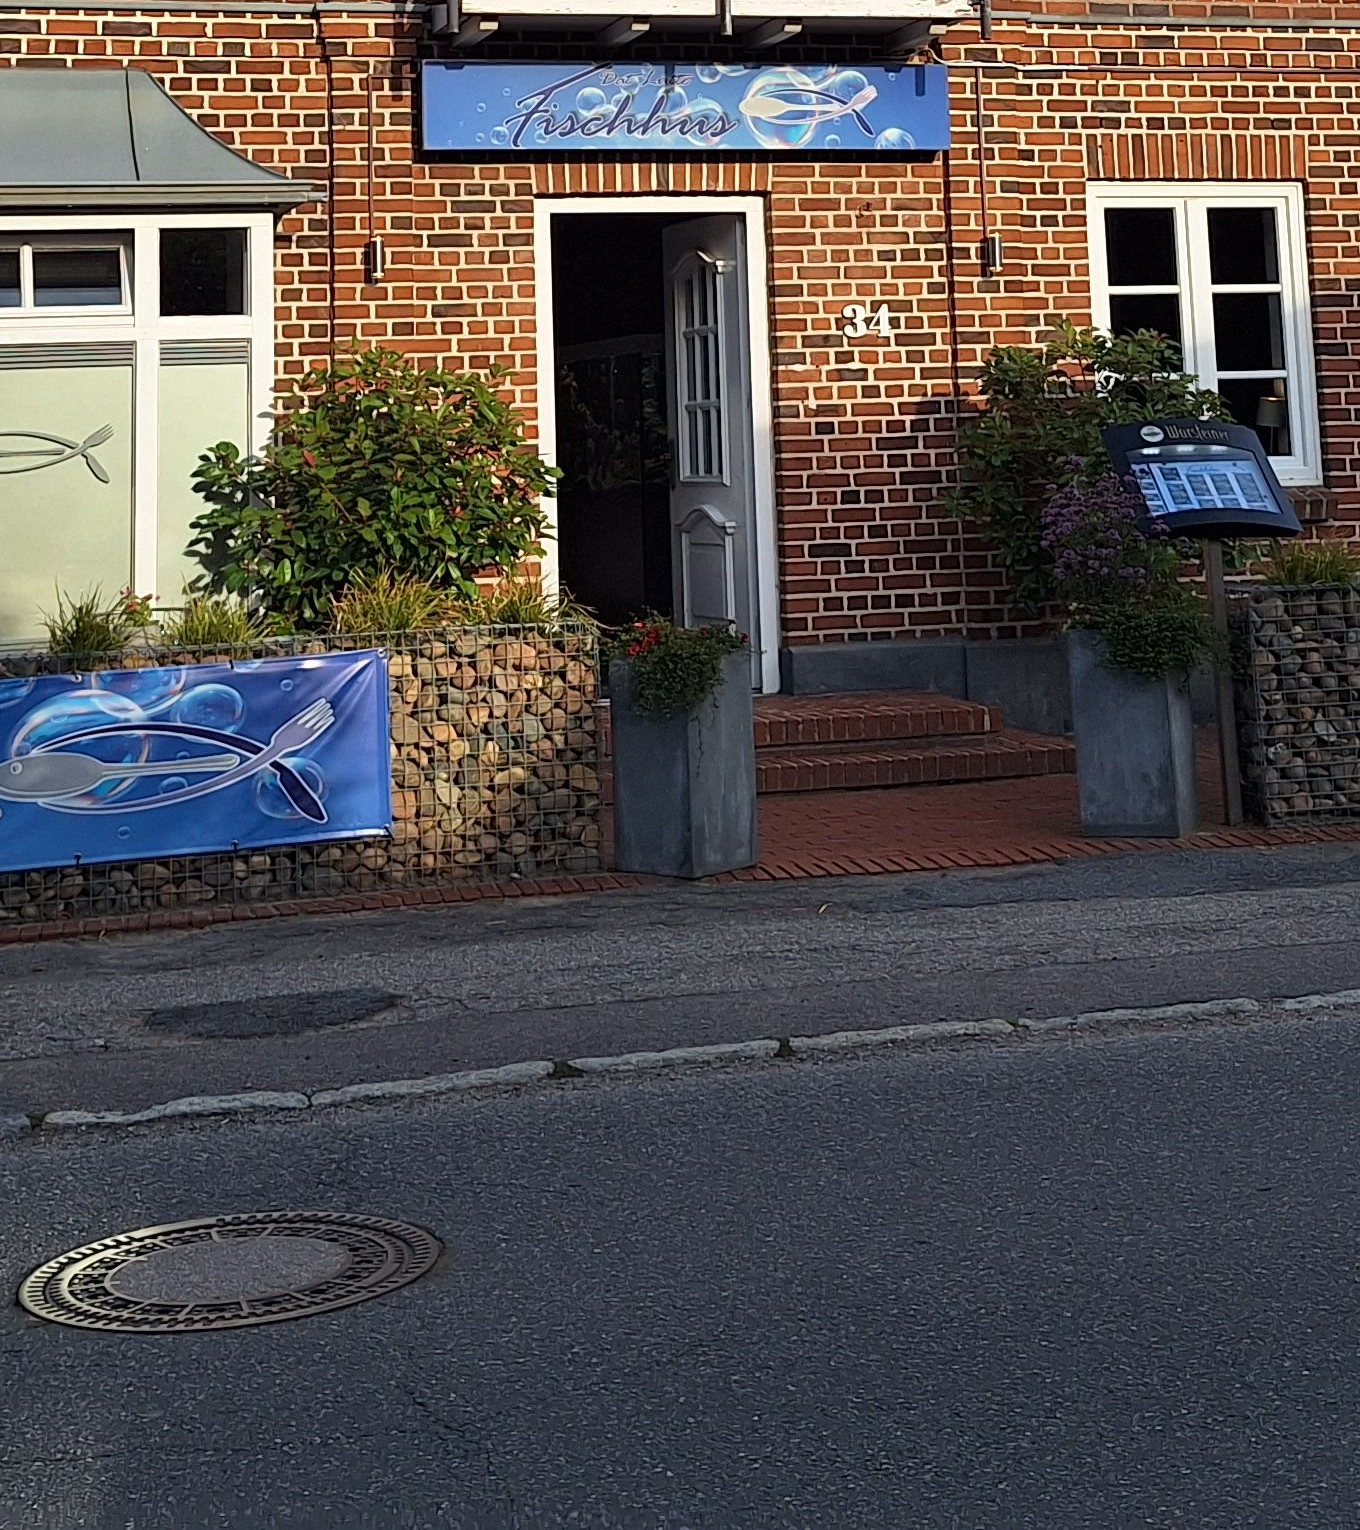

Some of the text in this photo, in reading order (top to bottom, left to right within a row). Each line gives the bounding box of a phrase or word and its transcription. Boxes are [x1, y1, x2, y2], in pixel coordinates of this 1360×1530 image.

[504, 61, 738, 148] Fischhus
[842, 303, 892, 338] 34
[1165, 424, 1230, 442] Warsteiner
